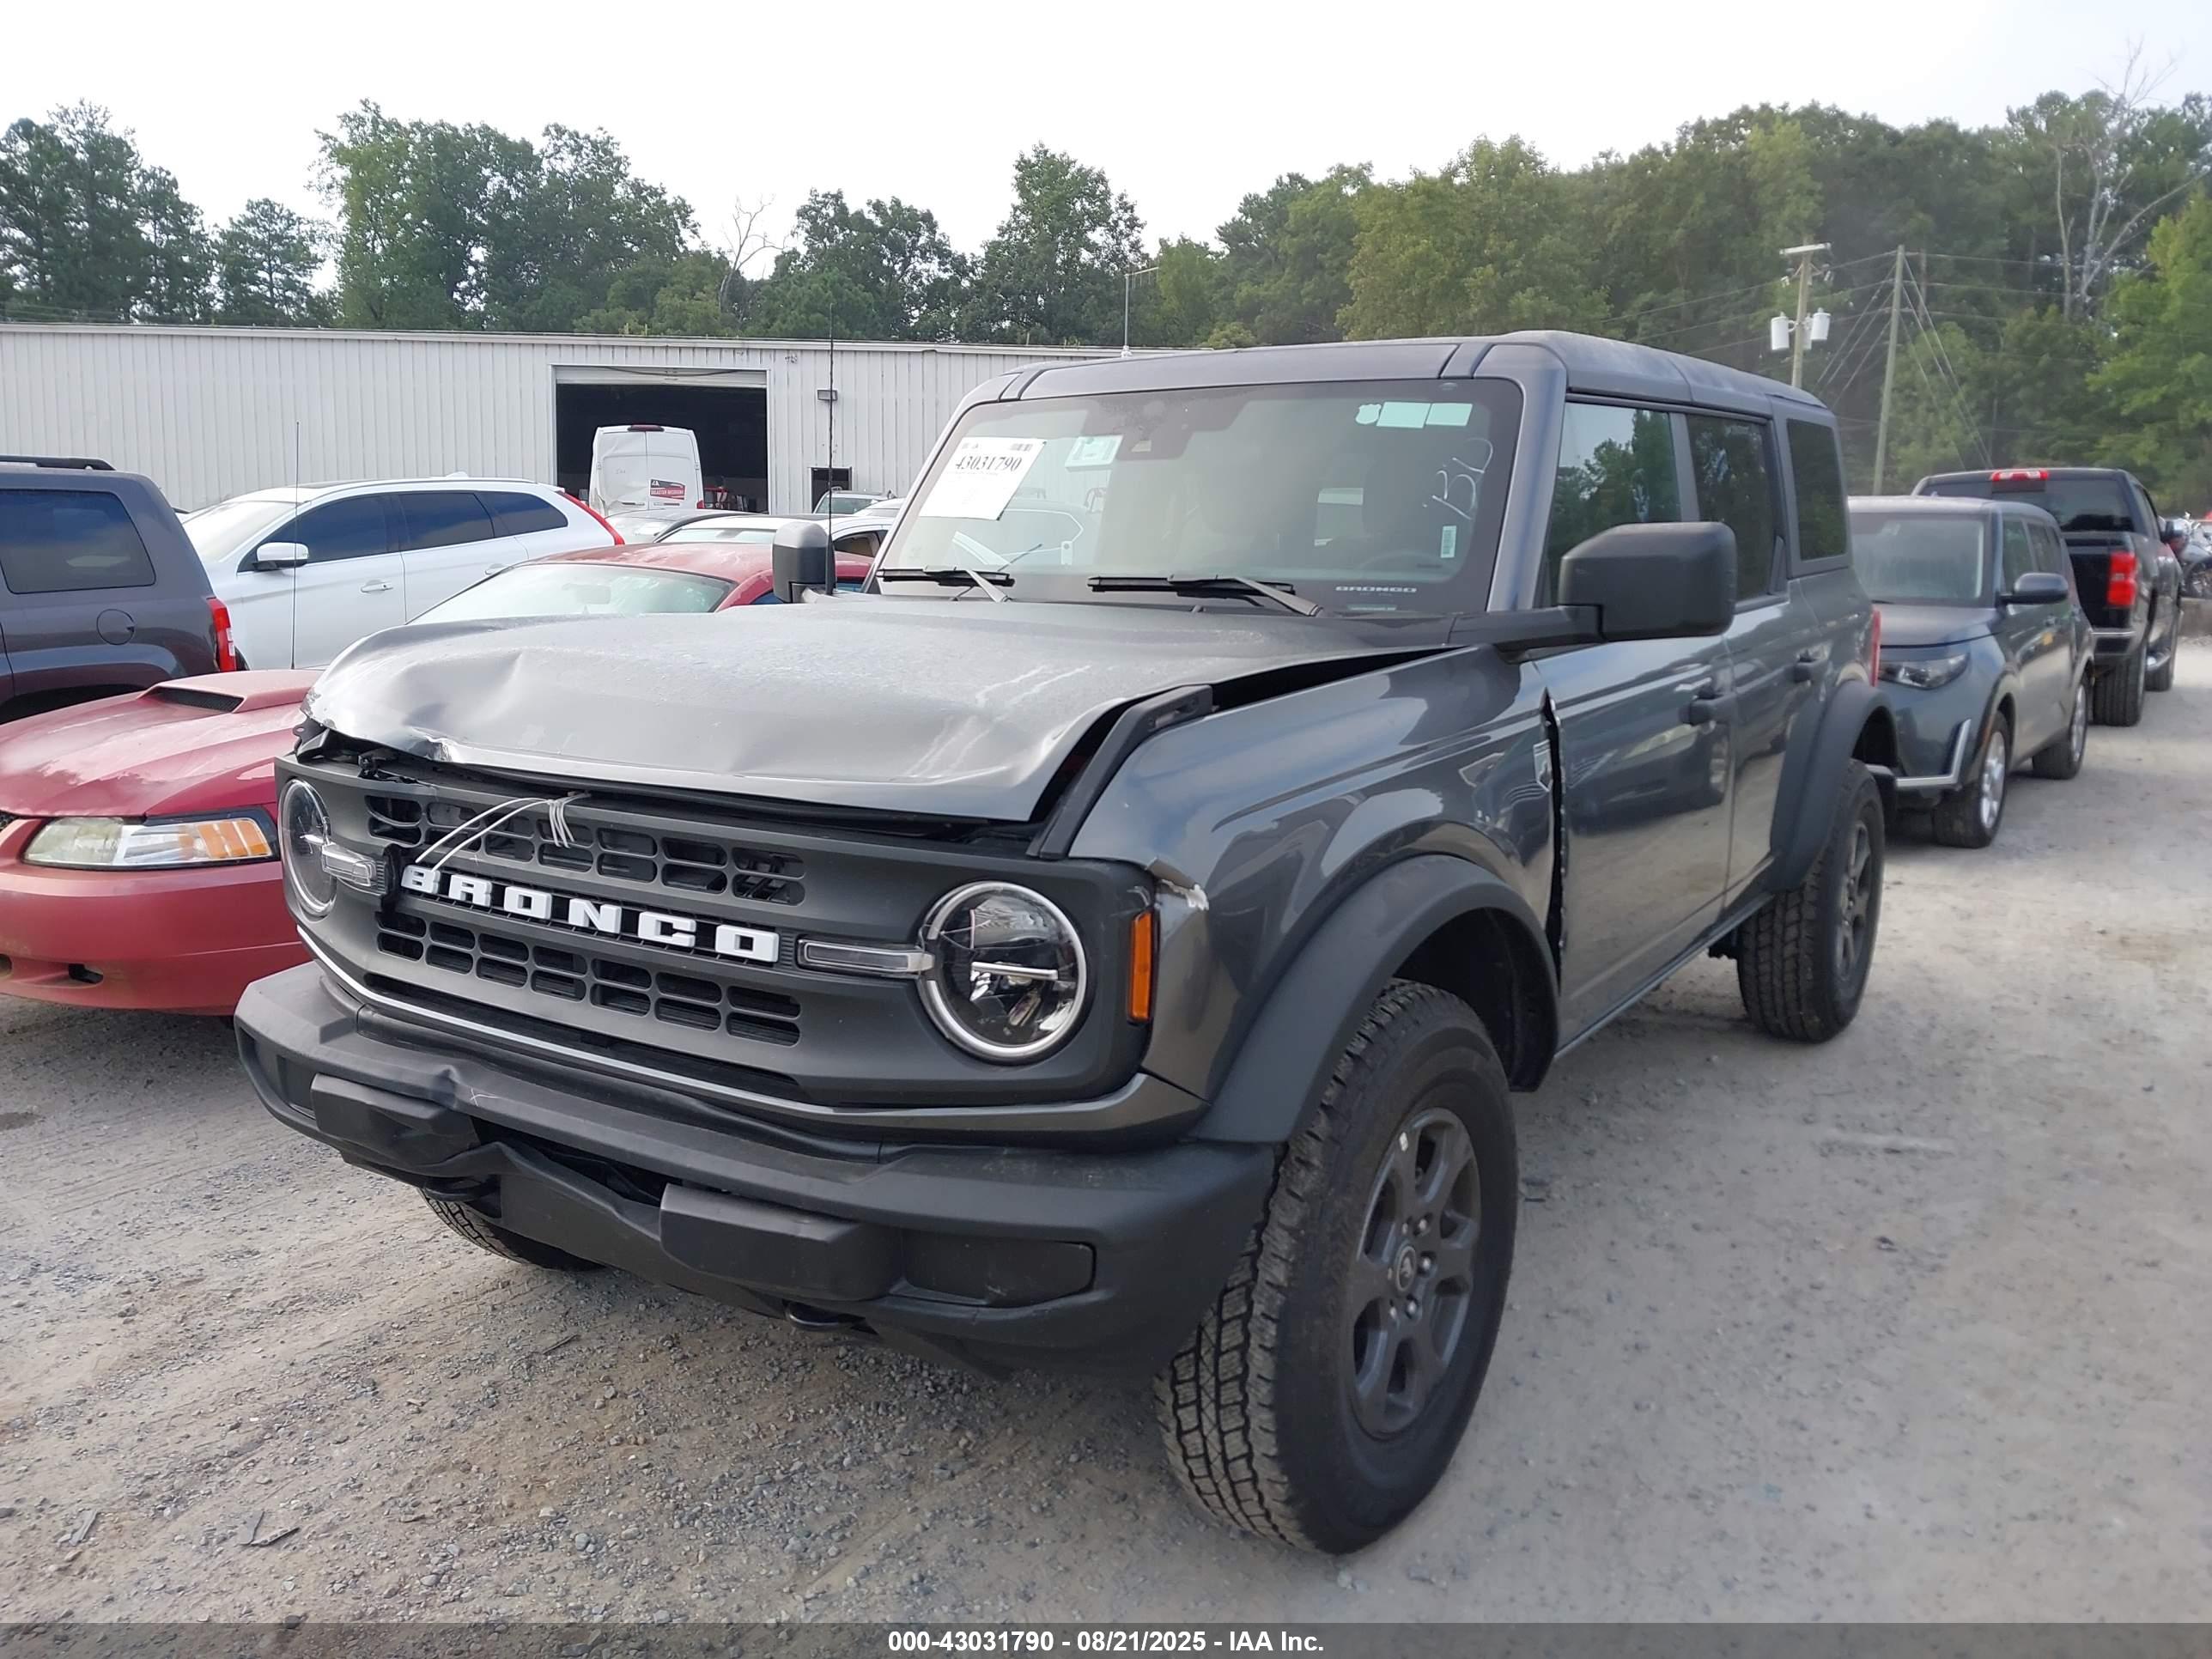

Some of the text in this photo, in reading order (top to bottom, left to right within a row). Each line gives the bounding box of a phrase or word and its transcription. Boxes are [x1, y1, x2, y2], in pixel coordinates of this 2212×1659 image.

[955, 455, 1023, 471] 43031790
[1334, 585, 1418, 593] BRONCO
[400, 863, 780, 963] BRONCO
